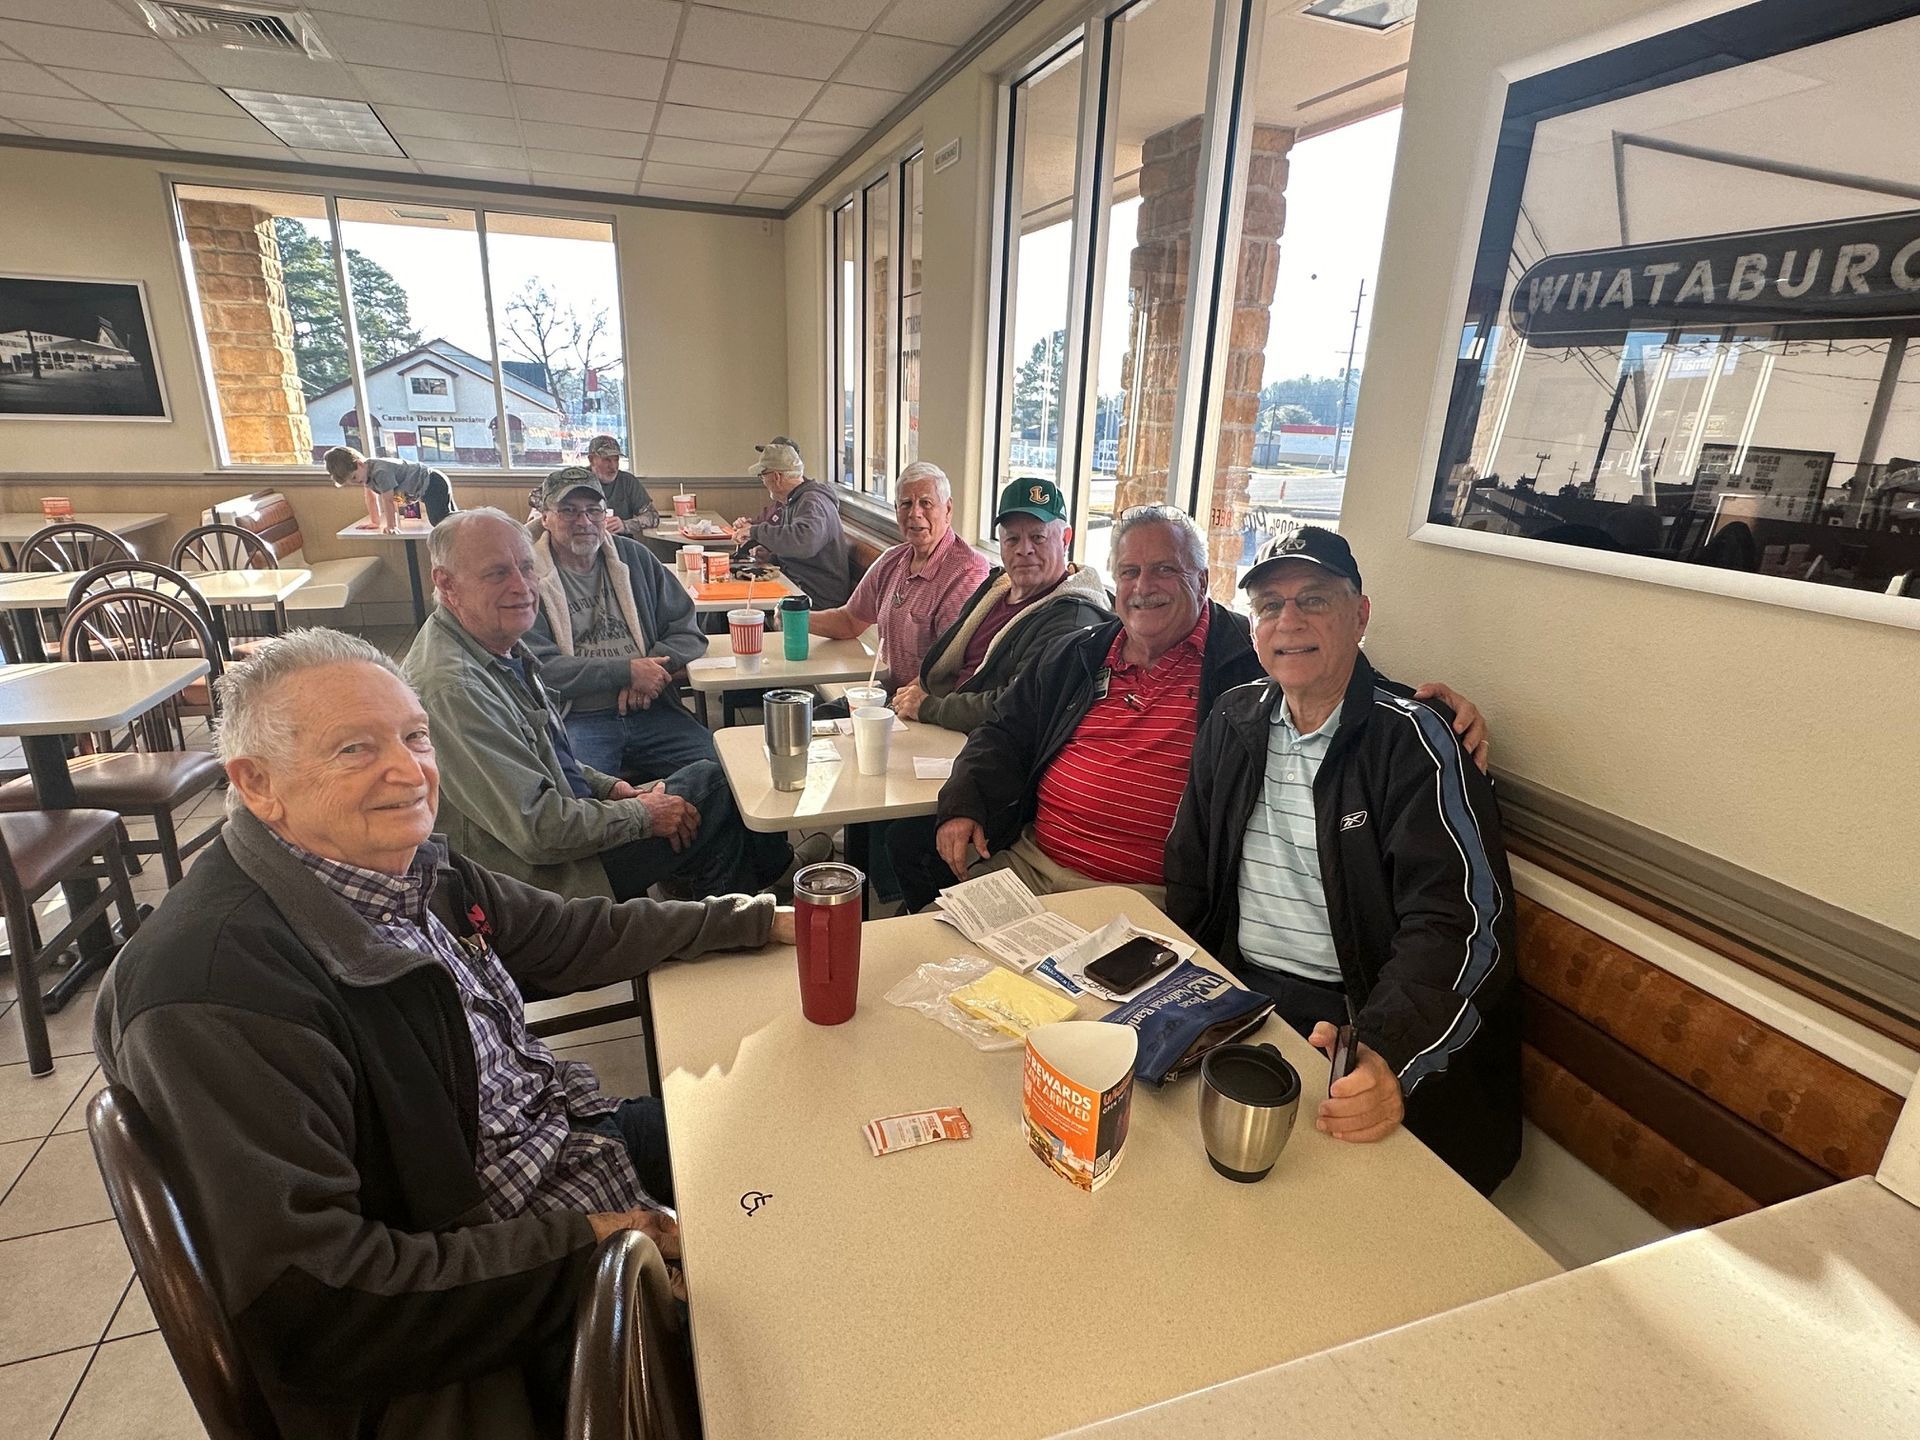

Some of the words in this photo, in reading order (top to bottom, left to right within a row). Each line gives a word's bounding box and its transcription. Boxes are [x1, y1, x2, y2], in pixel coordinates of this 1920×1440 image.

[381, 414, 414, 422] Carmela
[1150, 986, 1190, 1011] National
[1030, 1055, 1092, 1111] REWARDS
[1042, 1086, 1092, 1123] ARRIVED
